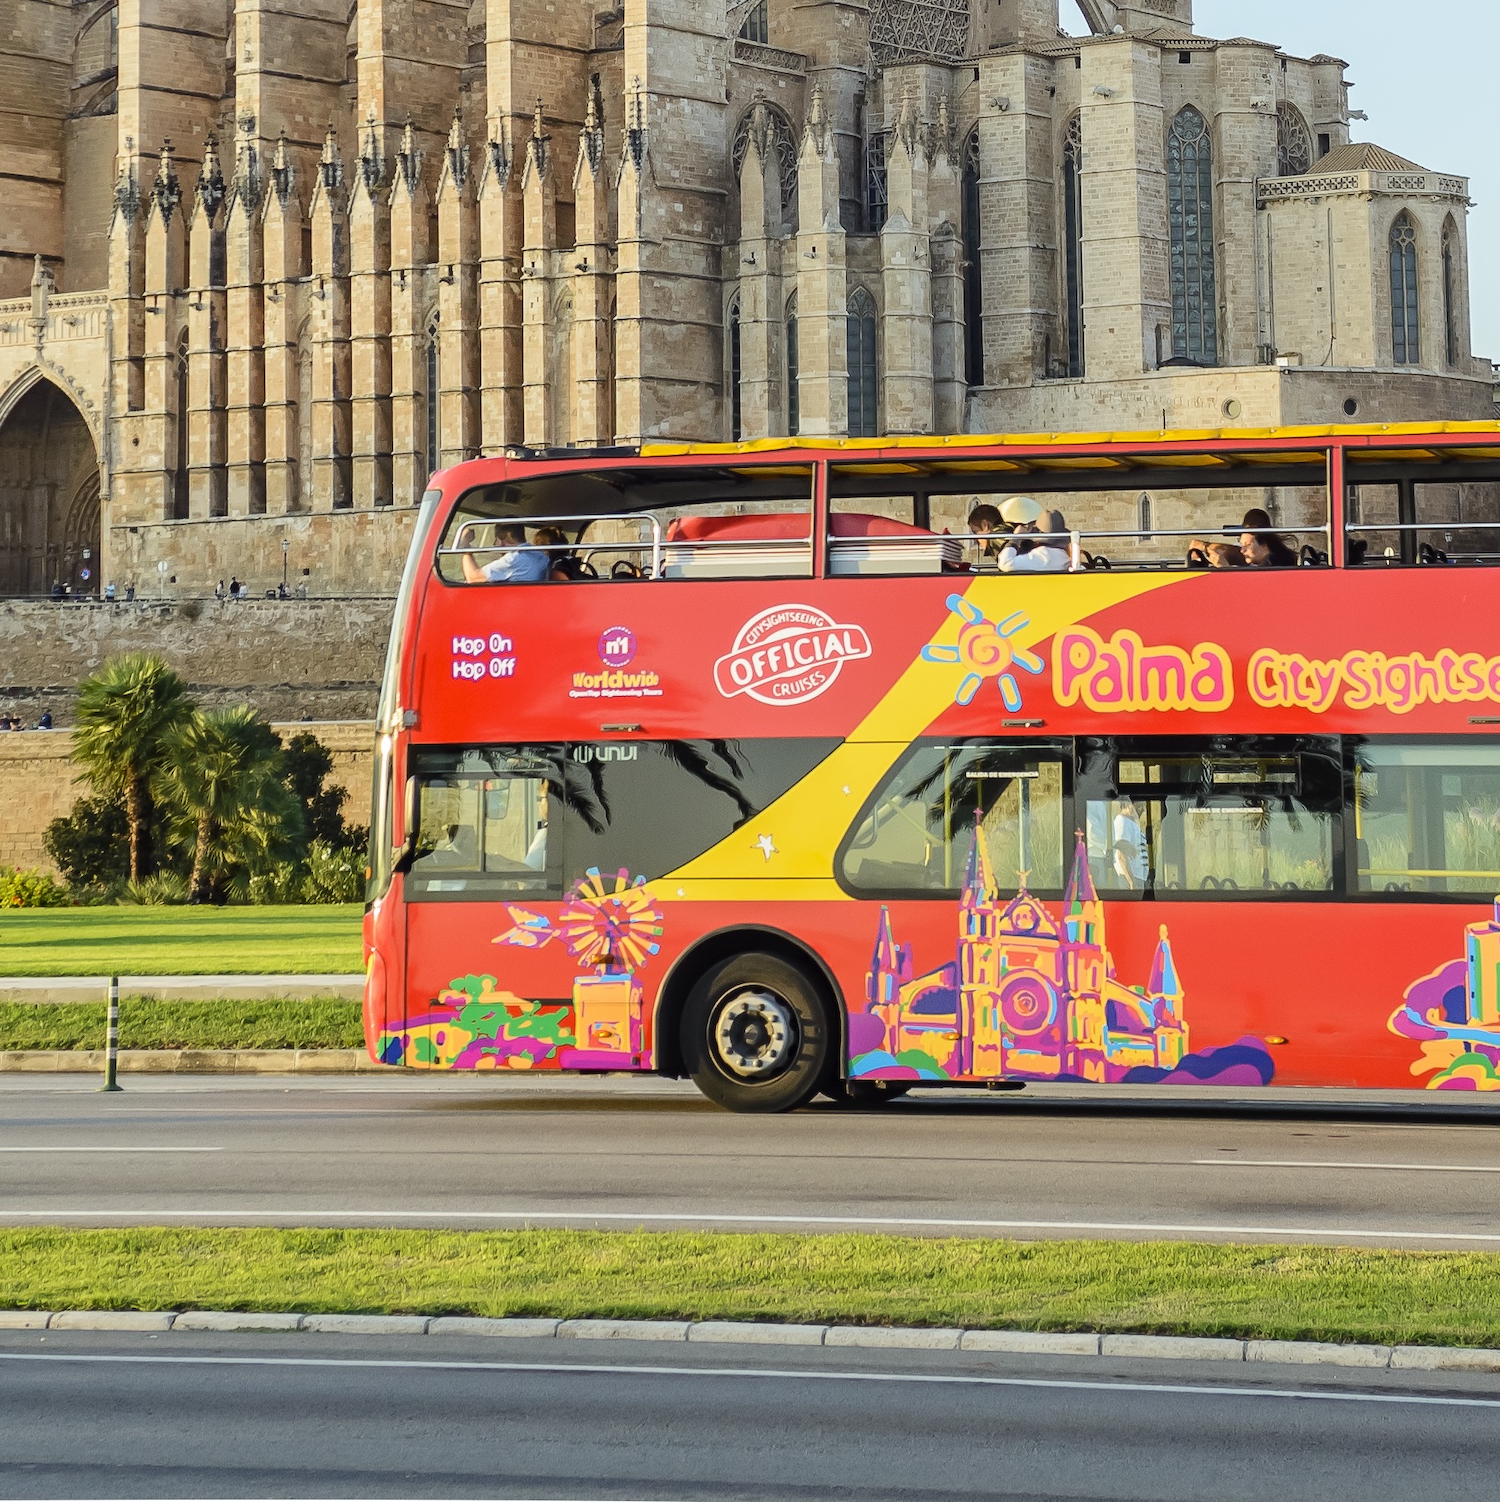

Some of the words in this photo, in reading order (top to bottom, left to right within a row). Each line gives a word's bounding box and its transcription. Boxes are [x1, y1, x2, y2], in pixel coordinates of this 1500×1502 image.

[746, 611, 825, 645] CITYSIGHTSEEING
[452, 637, 485, 656] Hop
[489, 633, 512, 653] On
[452, 660, 486, 680] Hop
[489, 658, 515, 678] Off
[730, 631, 860, 686] OFFICIAL
[1053, 626, 1232, 710] Palma
[572, 670, 659, 688] Worldwide
[772, 670, 826, 697] CRUISES
